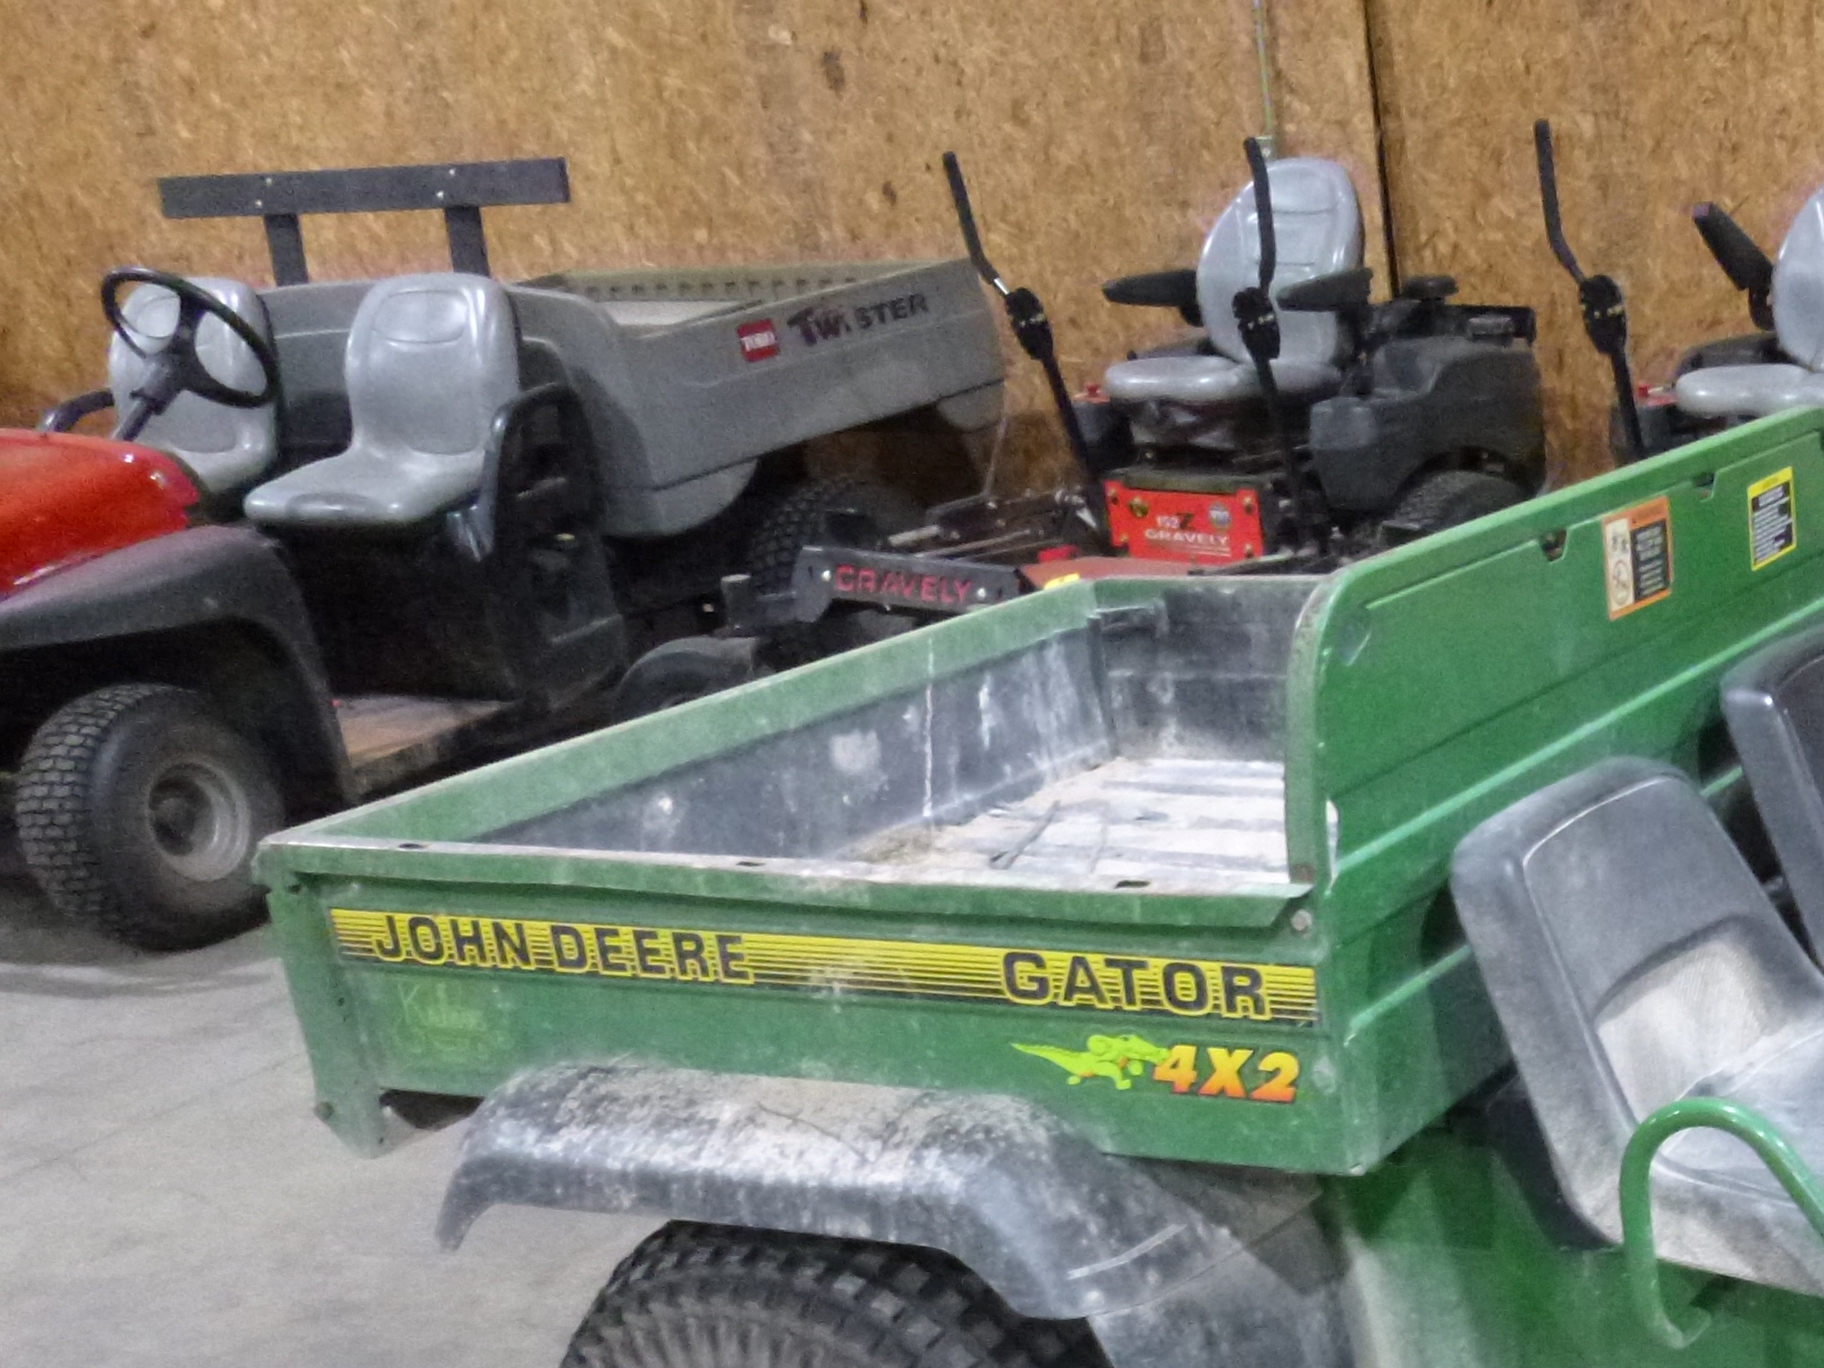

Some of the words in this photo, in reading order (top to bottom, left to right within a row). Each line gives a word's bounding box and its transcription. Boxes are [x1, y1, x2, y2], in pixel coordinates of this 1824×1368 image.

[1144, 527, 1229, 546] GRAVELY
[835, 562, 974, 603] GRAVELY
[375, 912, 536, 971] JOHN
[549, 923, 755, 986] DEERE
[1002, 949, 1274, 1022] GATOR
[1152, 1043, 1300, 1104] 4X2
